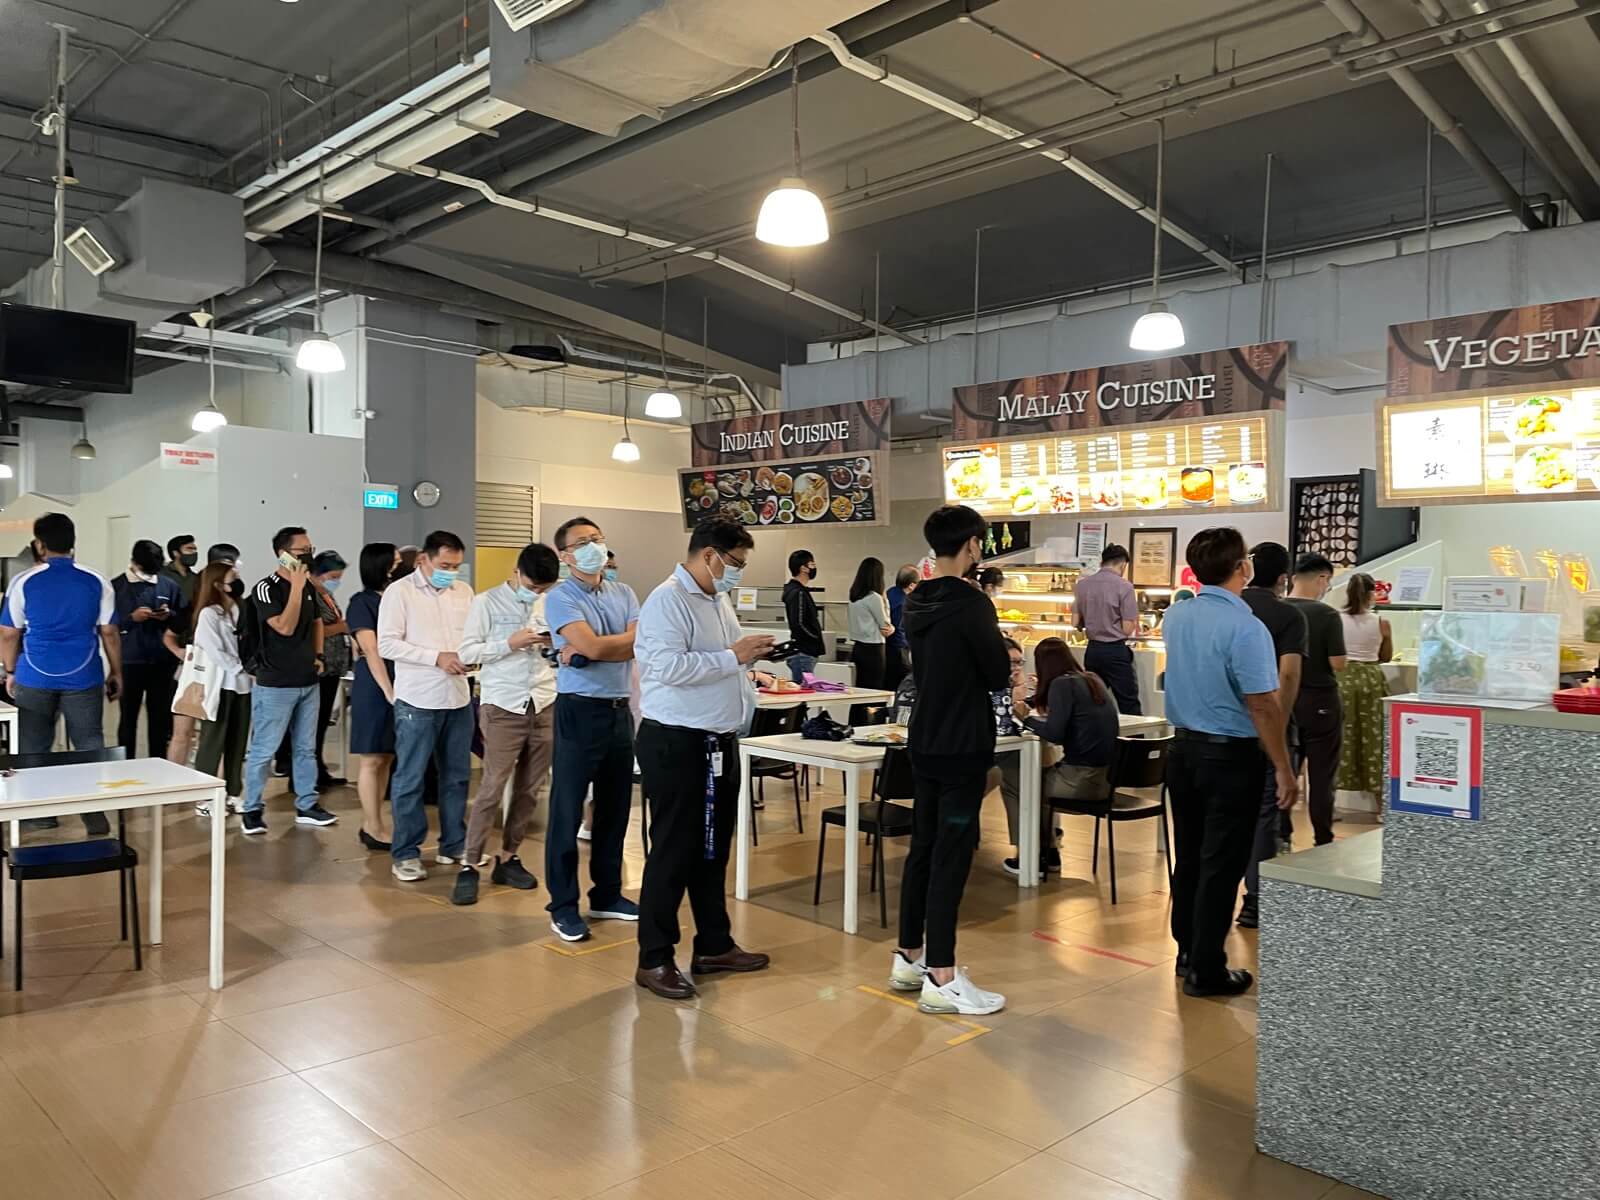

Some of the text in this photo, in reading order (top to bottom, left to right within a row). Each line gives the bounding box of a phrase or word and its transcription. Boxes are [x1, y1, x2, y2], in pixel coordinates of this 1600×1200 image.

[1424, 325, 1600, 373] VEGETA
[997, 374, 1216, 422] MALAY CUISINE
[719, 420, 849, 453] INDIAN CUISINE
[367, 493, 388, 505] EXIT
